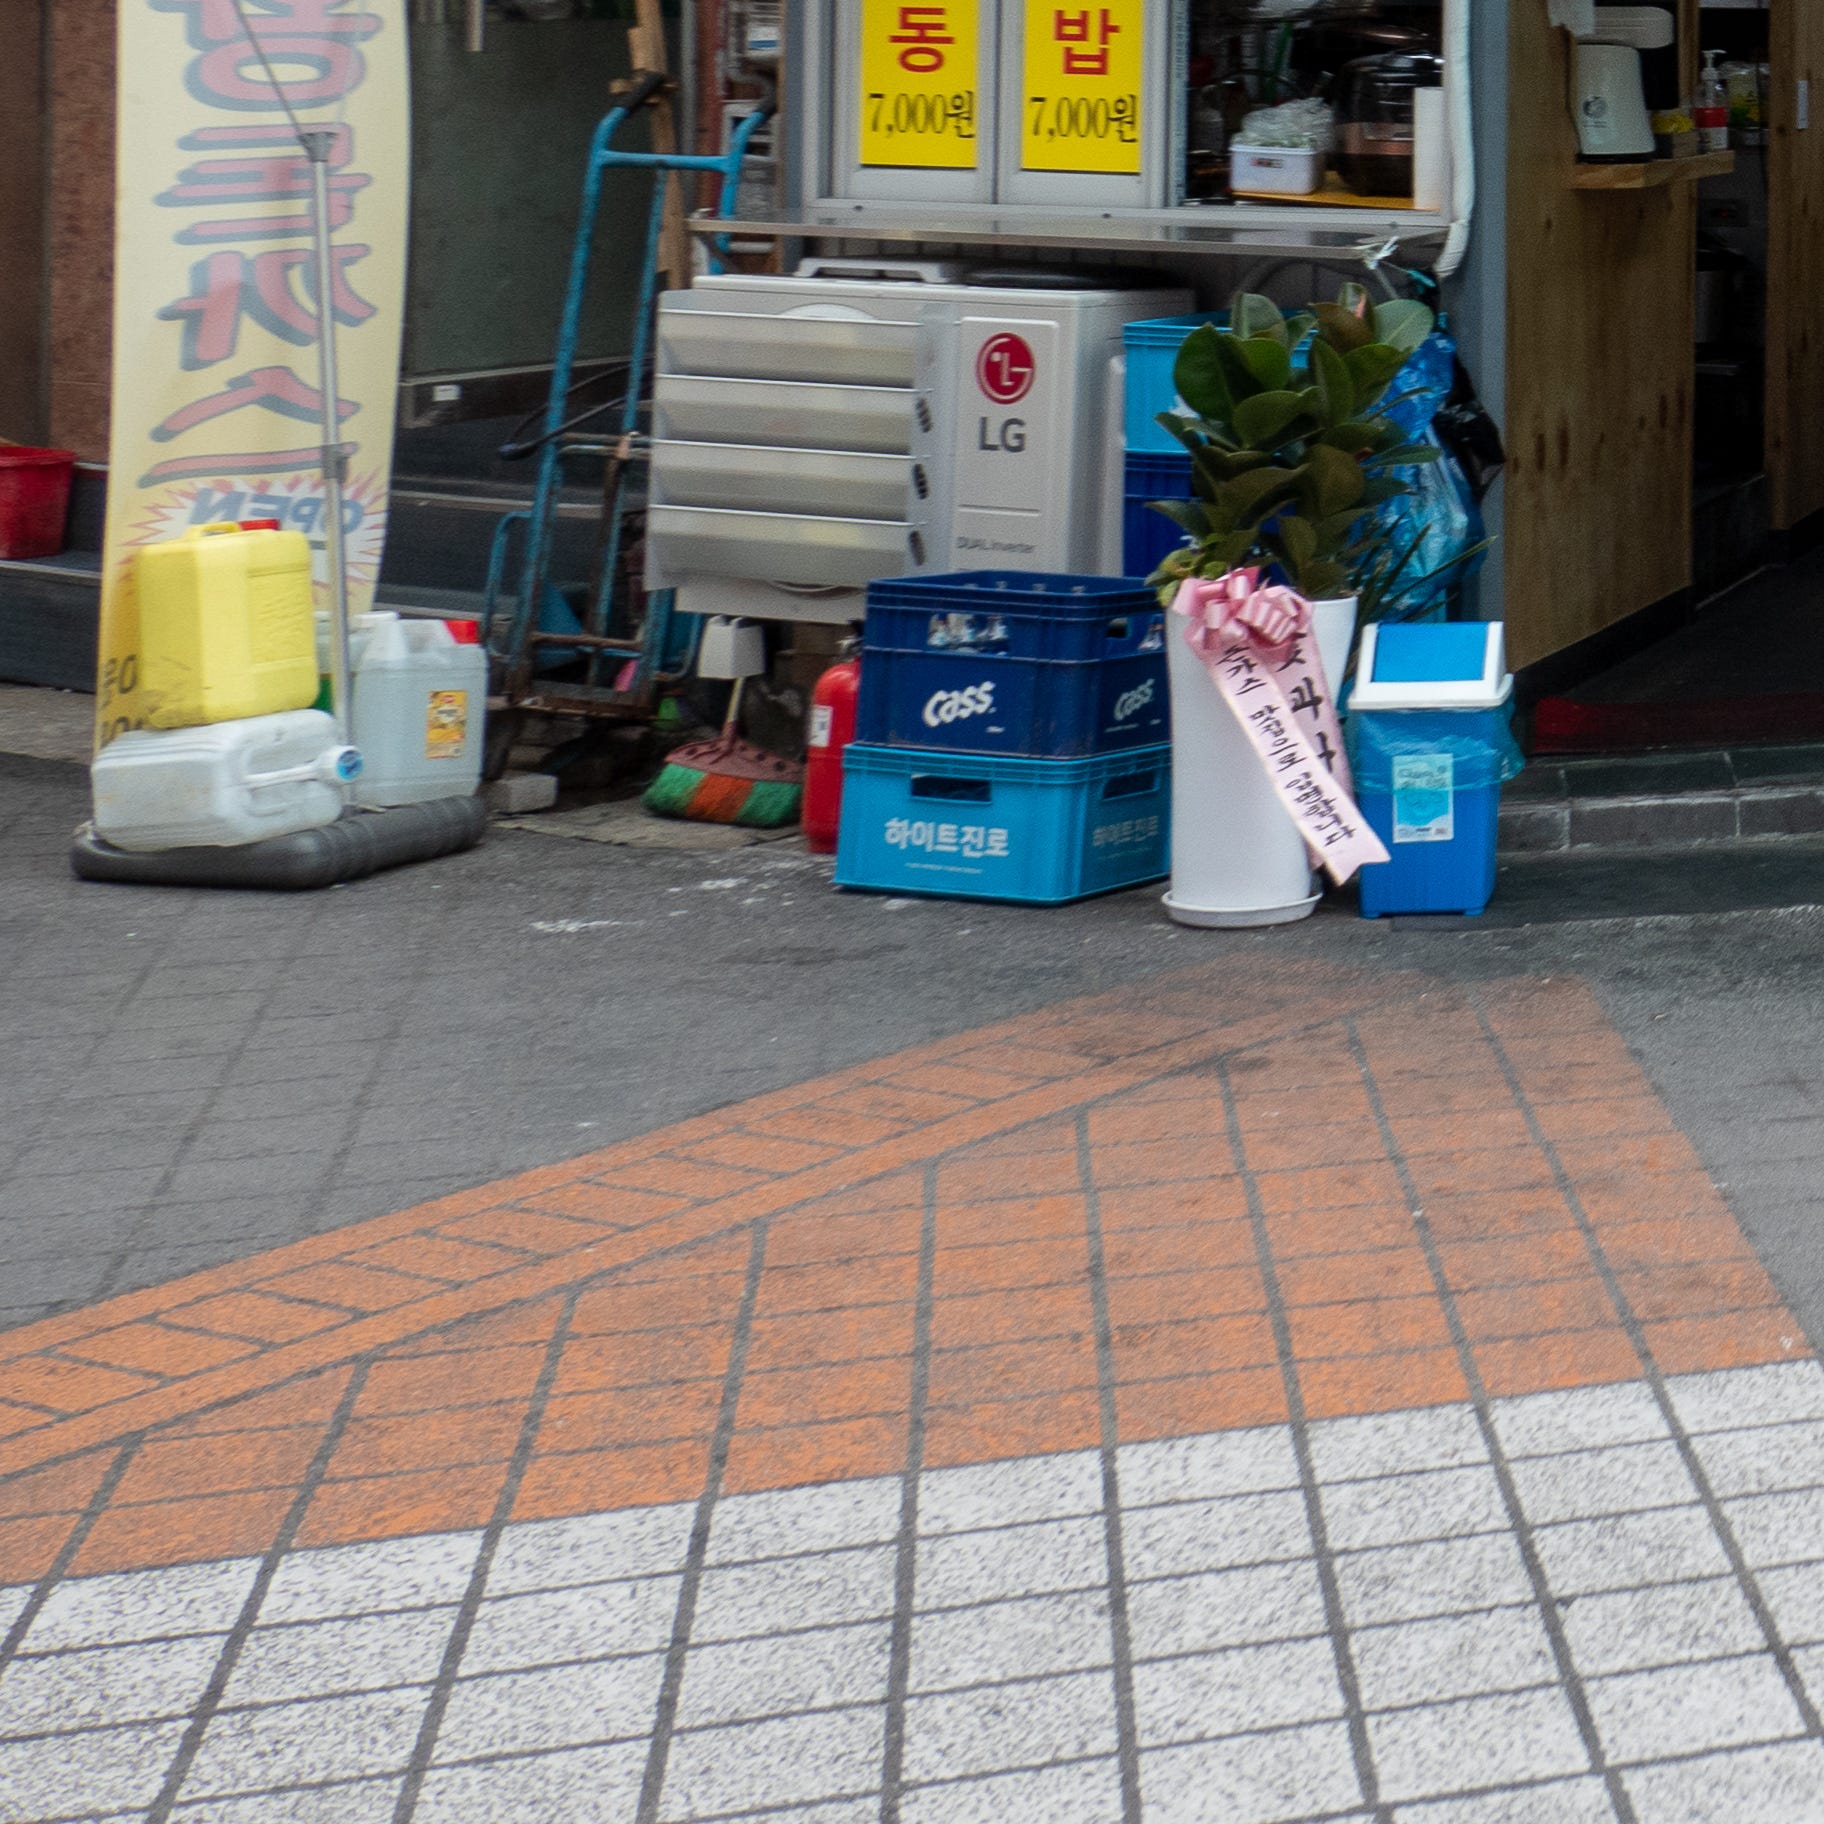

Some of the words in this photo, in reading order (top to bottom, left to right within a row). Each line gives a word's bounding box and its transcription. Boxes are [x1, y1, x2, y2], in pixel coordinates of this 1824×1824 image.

[869, 89, 974, 139] 7,000원
[1029, 95, 1138, 144] 7,000원
[979, 417, 1026, 453] LG
[884, 818, 1009, 858] 하이트진로
